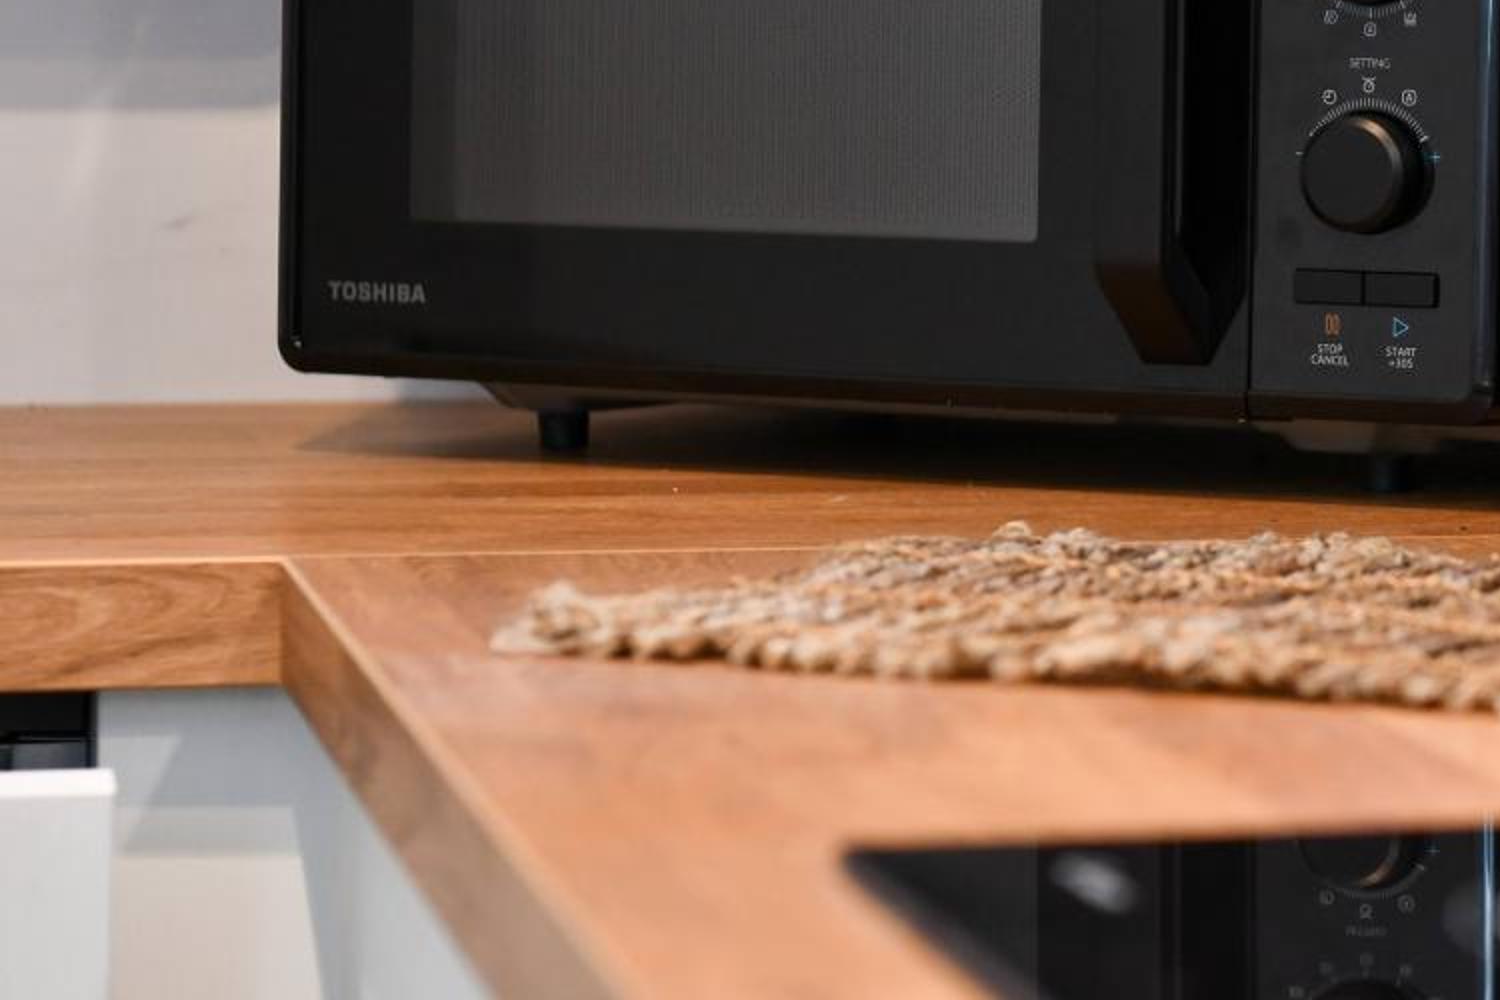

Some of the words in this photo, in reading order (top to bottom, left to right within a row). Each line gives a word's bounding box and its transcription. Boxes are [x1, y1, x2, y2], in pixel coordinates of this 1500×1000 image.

[1349, 57, 1391, 69] SETTING
[328, 279, 426, 304] TOSHIBA
[1317, 343, 1343, 355] STOP
[1385, 346, 1417, 357] START
[1310, 354, 1350, 367] CANCEL
